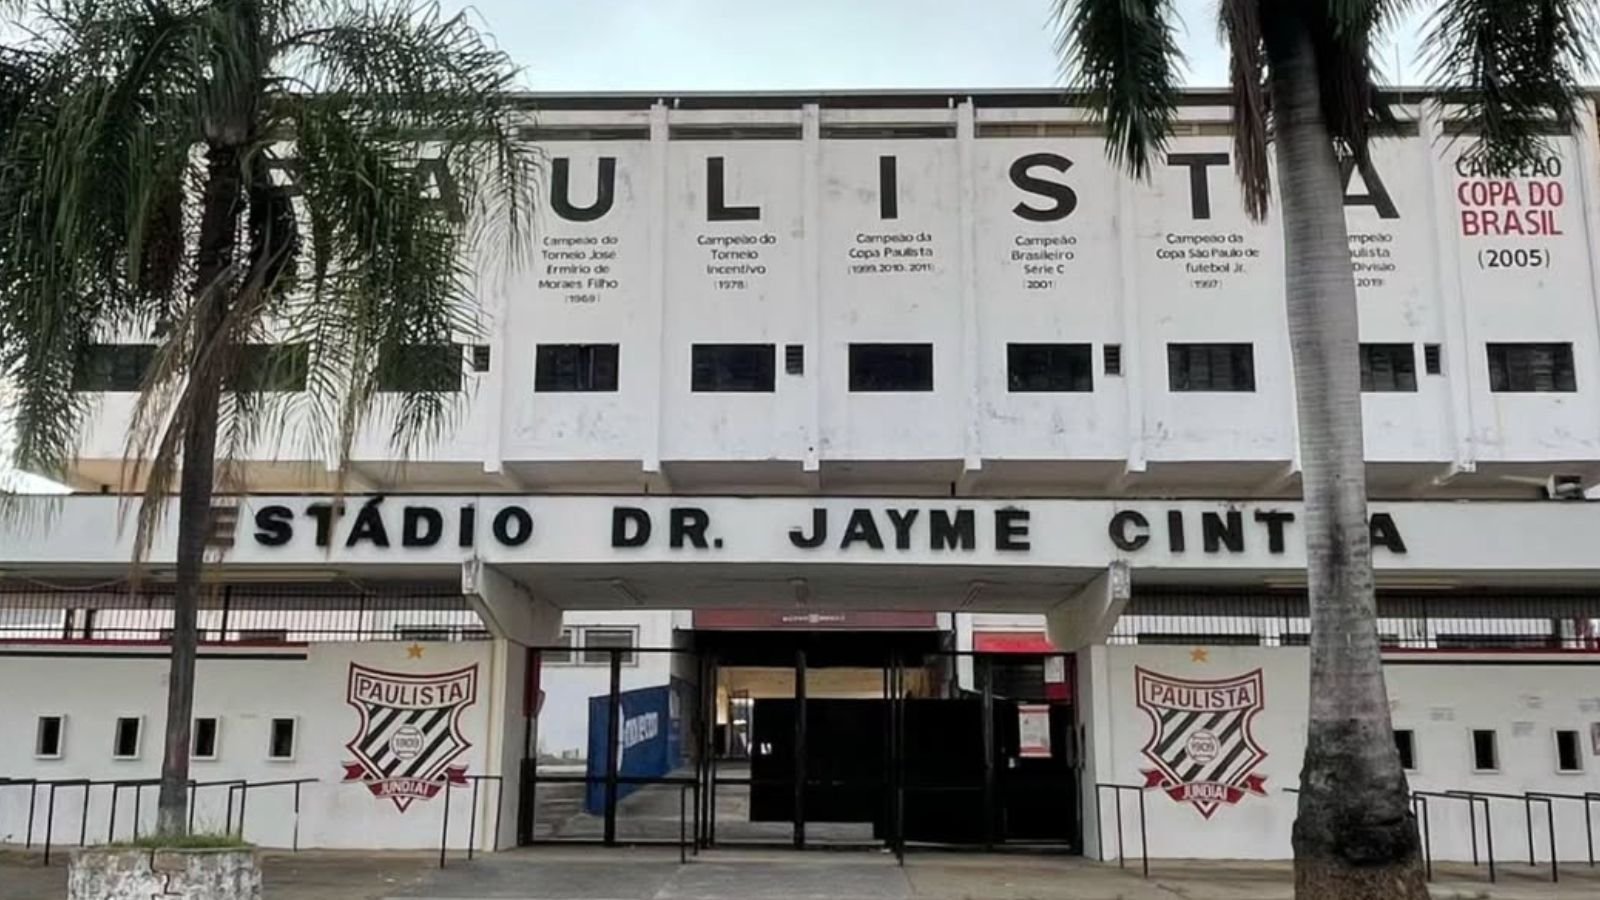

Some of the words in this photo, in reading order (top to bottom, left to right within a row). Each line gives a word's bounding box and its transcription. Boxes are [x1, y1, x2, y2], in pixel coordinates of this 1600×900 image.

[1458, 181, 1521, 206] COPA
[1528, 181, 1564, 206] DO
[1461, 210, 1564, 236] BRASIL
[601, 236, 618, 245] do
[697, 234, 757, 248] Campeão
[759, 233, 777, 245] do
[915, 232, 932, 242] da
[1015, 235, 1077, 248] Campeão
[1227, 233, 1244, 244] da
[1349, 233, 1392, 245] mpeão
[541, 249, 586, 261] Torneio
[711, 248, 759, 260] Torneio
[848, 247, 881, 260] Copa
[883, 247, 934, 258] Paulista
[1011, 250, 1075, 261] Brasileiro
[1156, 248, 1186, 261] Copa
[1211, 247, 1244, 259] Paulo
[1244, 248, 1260, 258] de
[1478, 249, 1551, 269] (2005)
[593, 264, 610, 274] de
[706, 264, 767, 275] Incentivo
[1056, 264, 1066, 274] C
[1186, 262, 1230, 274] futebol
[538, 279, 582, 290] Moraes
[587, 278, 619, 290] Filho
[1022, 279, 1057, 290] (2001)
[206, 496, 534, 549] ESTÁDIO
[611, 506, 724, 549] DR.
[788, 507, 1031, 551] JAYME
[1109, 509, 1408, 554] CINTA
[358, 678, 464, 706] PAULISTA
[1151, 683, 1251, 709] PAULISTA
